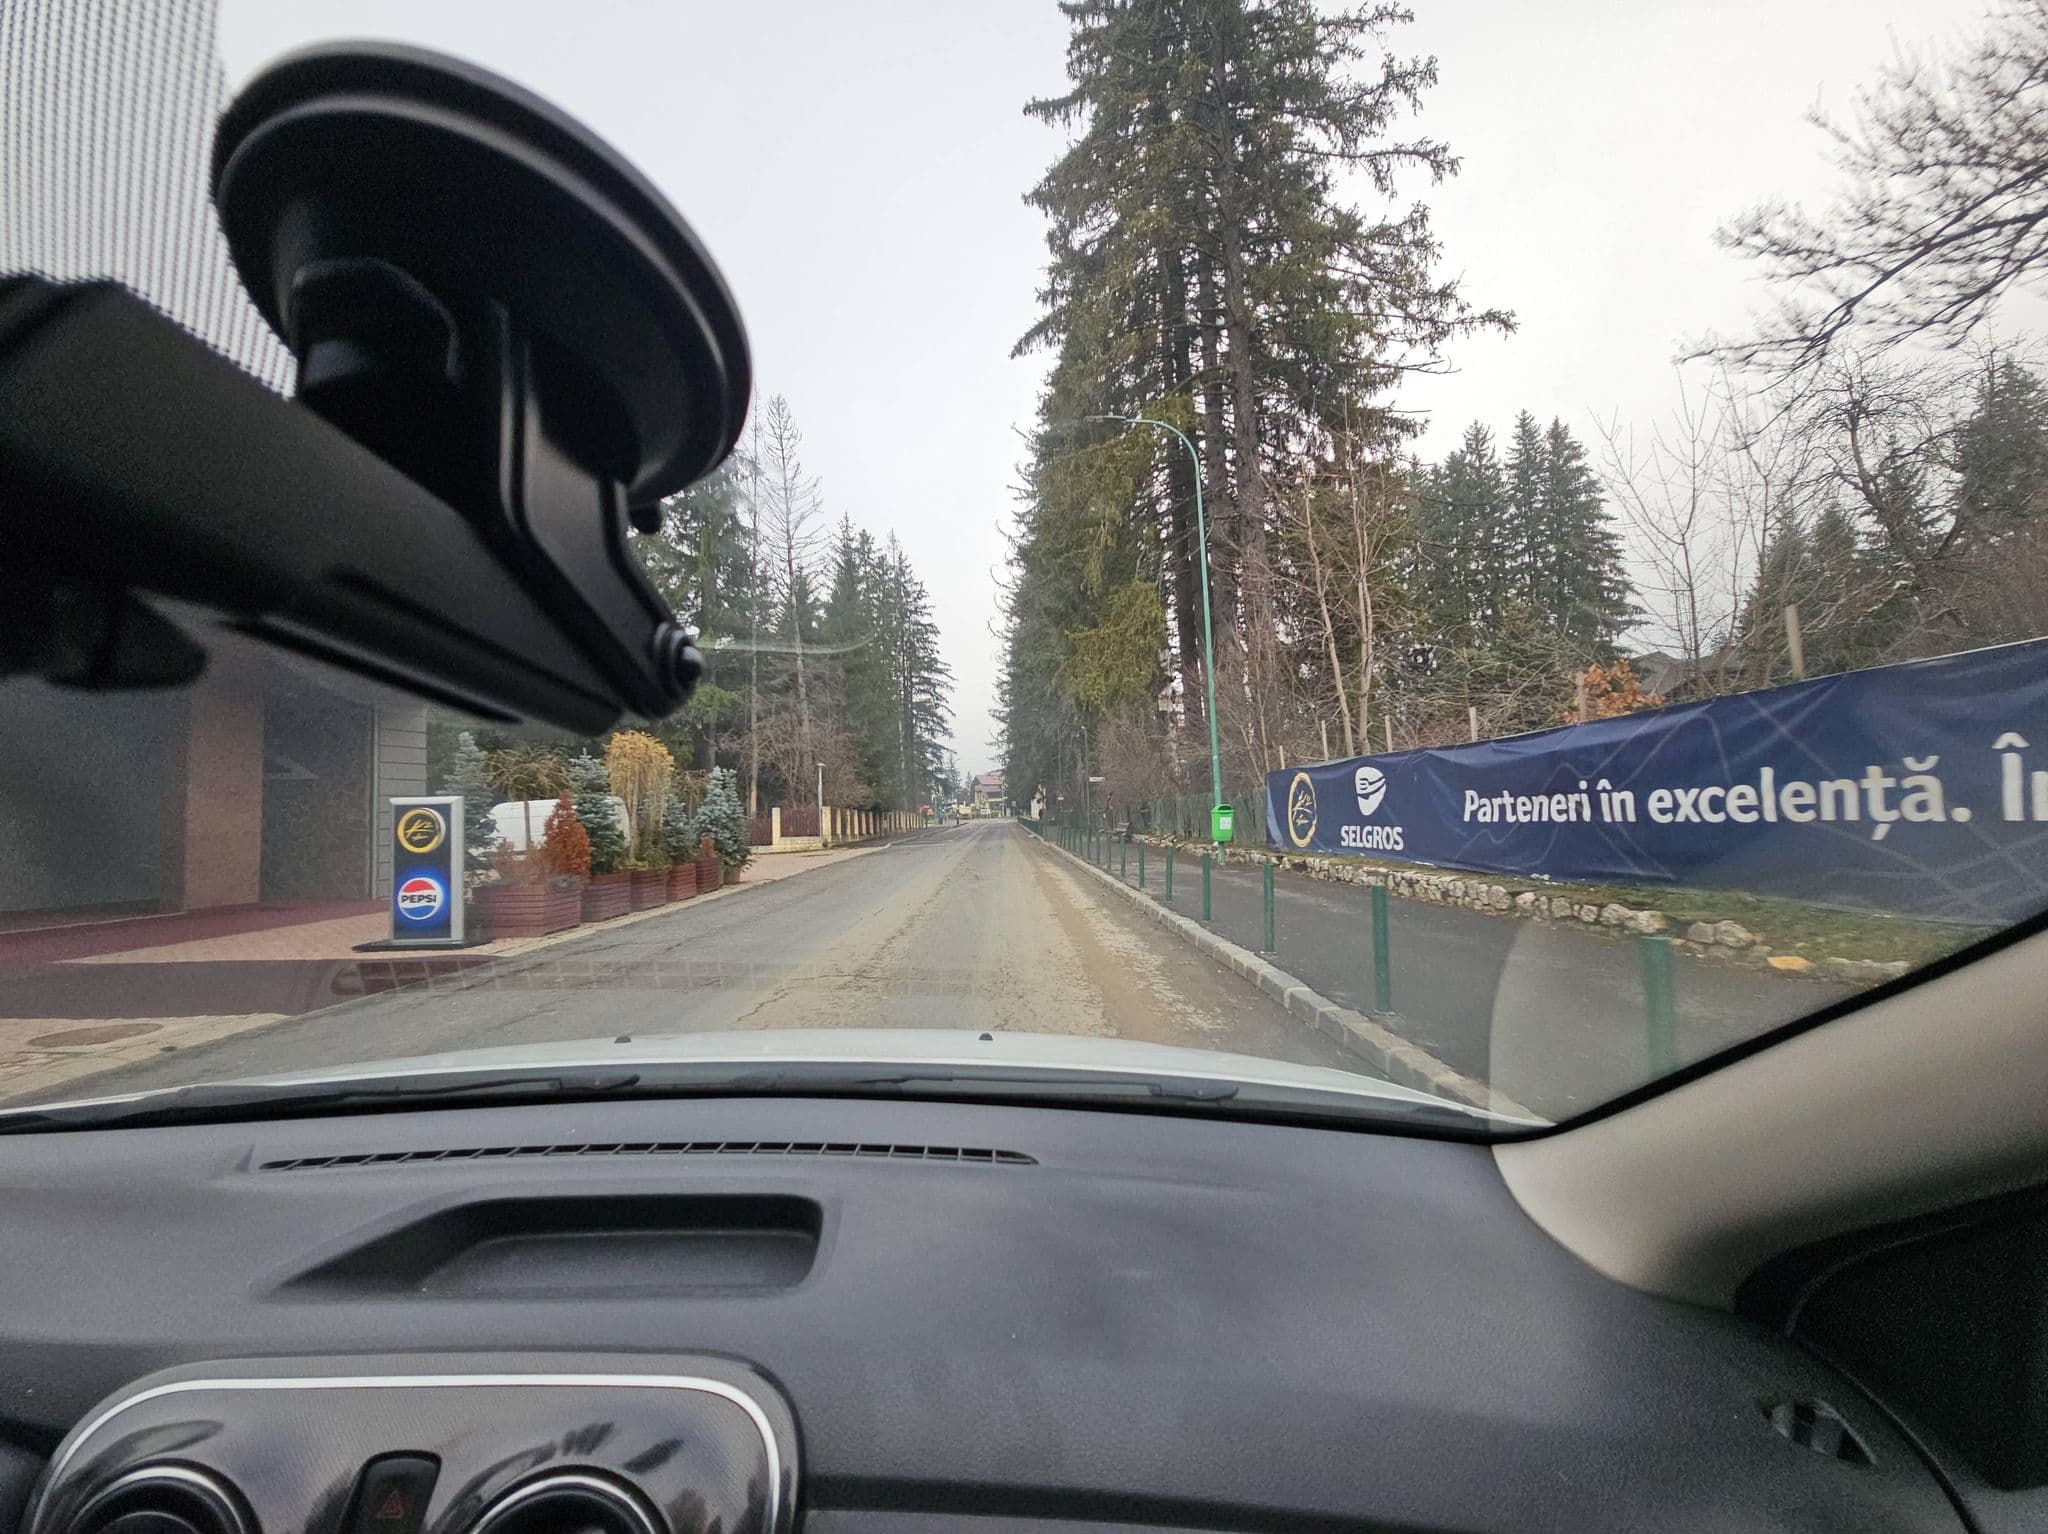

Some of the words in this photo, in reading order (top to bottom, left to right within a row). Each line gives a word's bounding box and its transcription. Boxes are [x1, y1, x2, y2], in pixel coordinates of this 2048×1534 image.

[1463, 779, 1592, 823] Parteneri
[1597, 778, 1637, 823] în
[1648, 755, 1973, 841] excelență.
[1340, 825, 1404, 851] SELGROS
[401, 894, 437, 904] PEPSI
